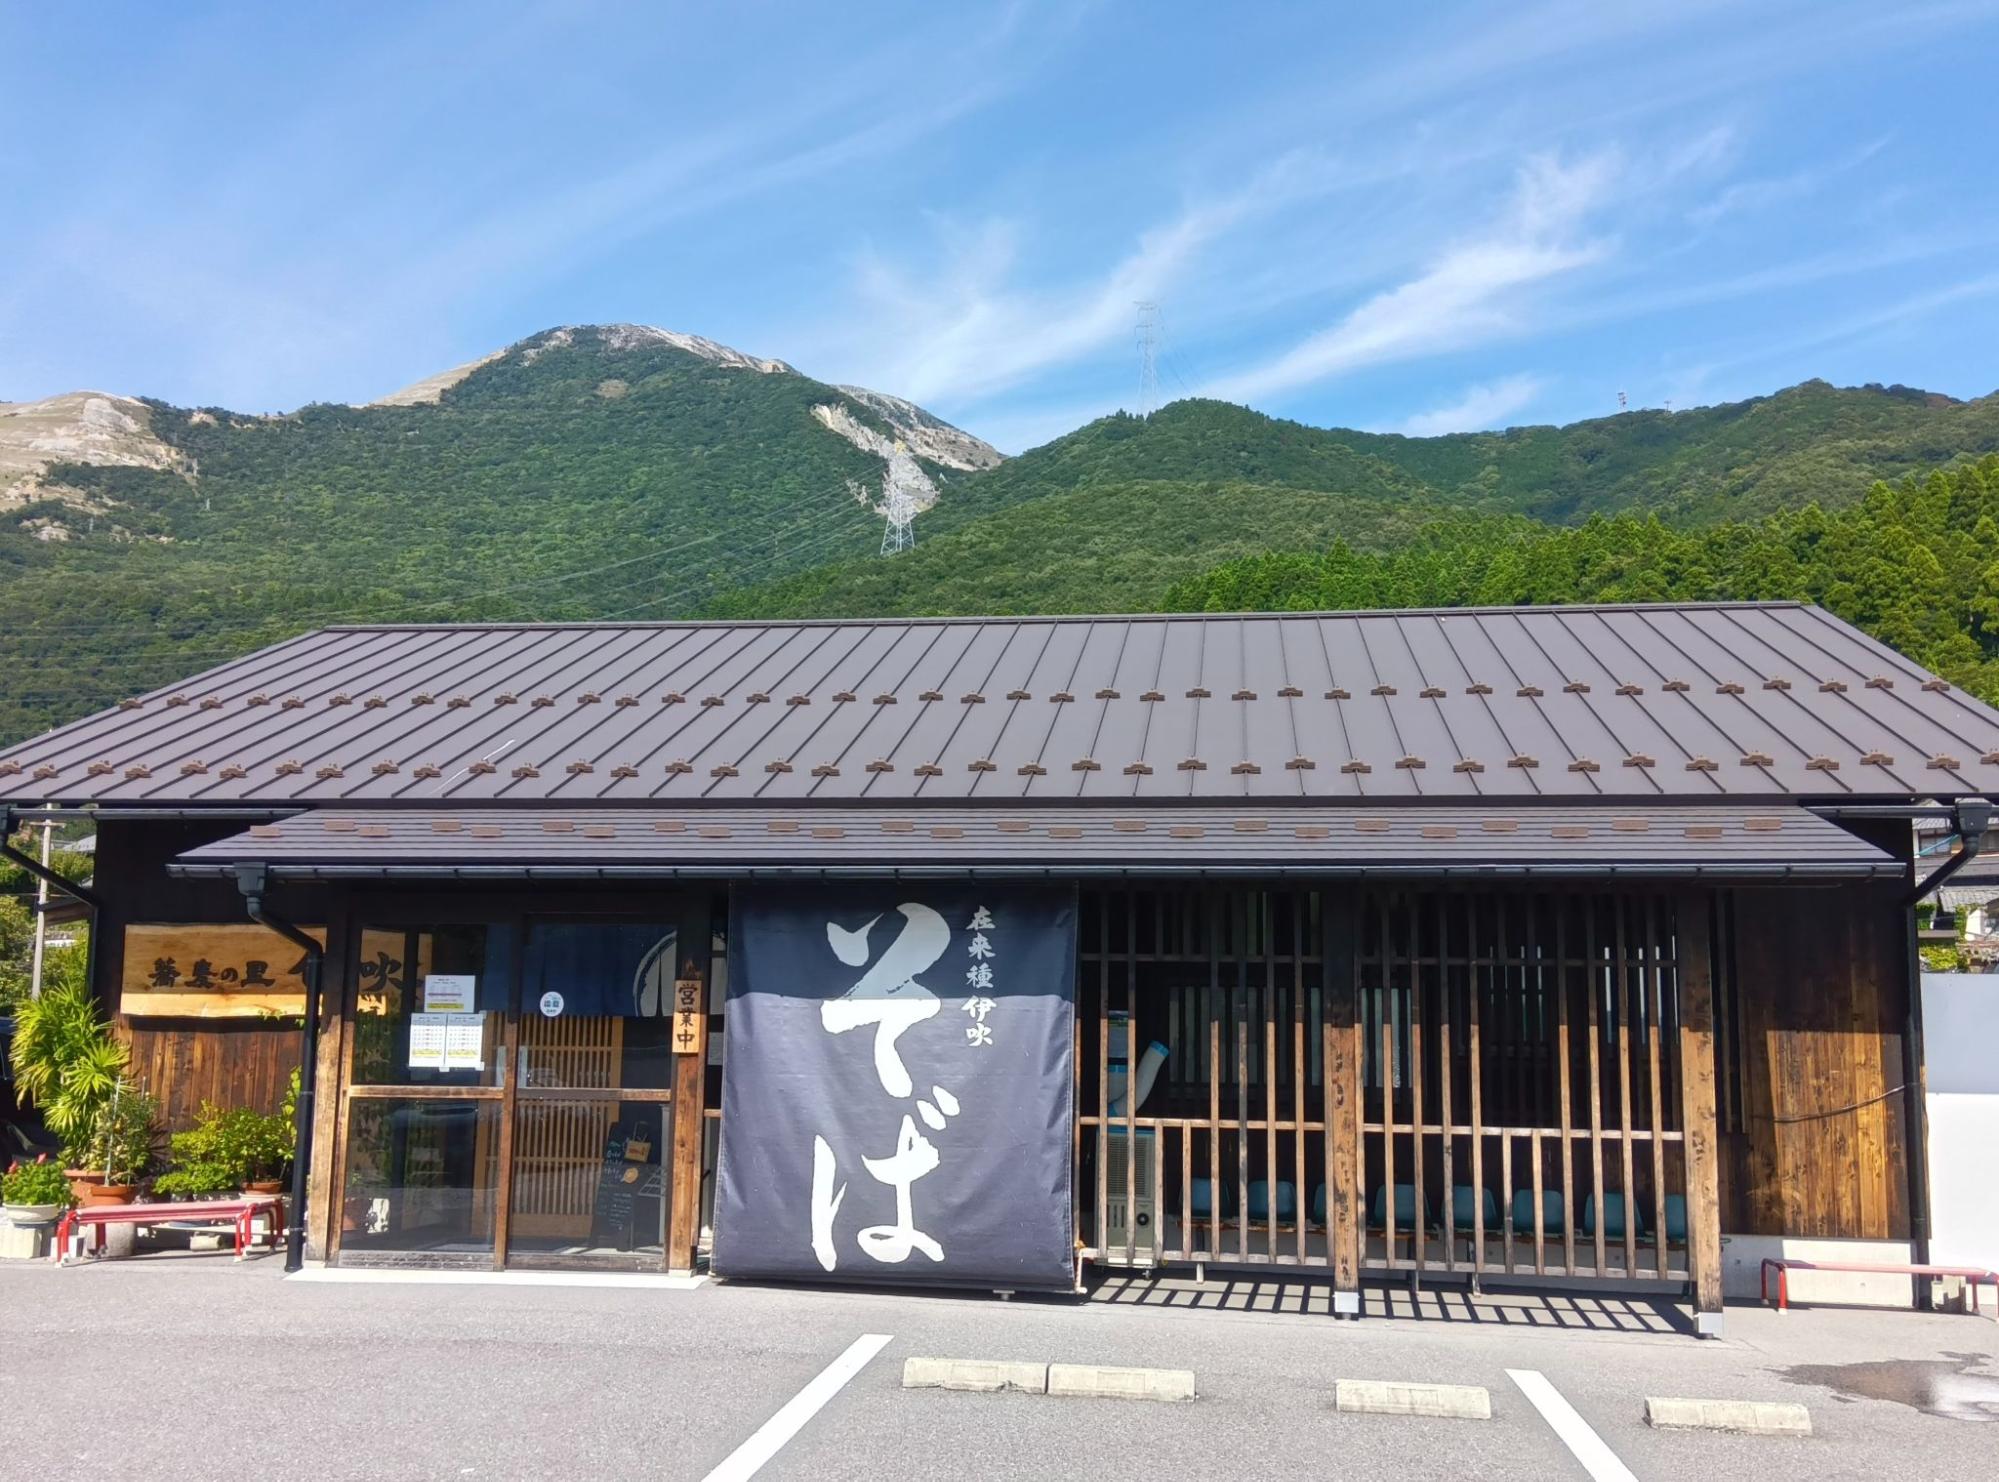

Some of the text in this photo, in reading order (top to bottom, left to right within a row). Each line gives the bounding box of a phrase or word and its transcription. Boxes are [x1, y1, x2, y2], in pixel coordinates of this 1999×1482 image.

[677, 983, 698, 1050] 営業中
[811, 902, 960, 1272] そば
